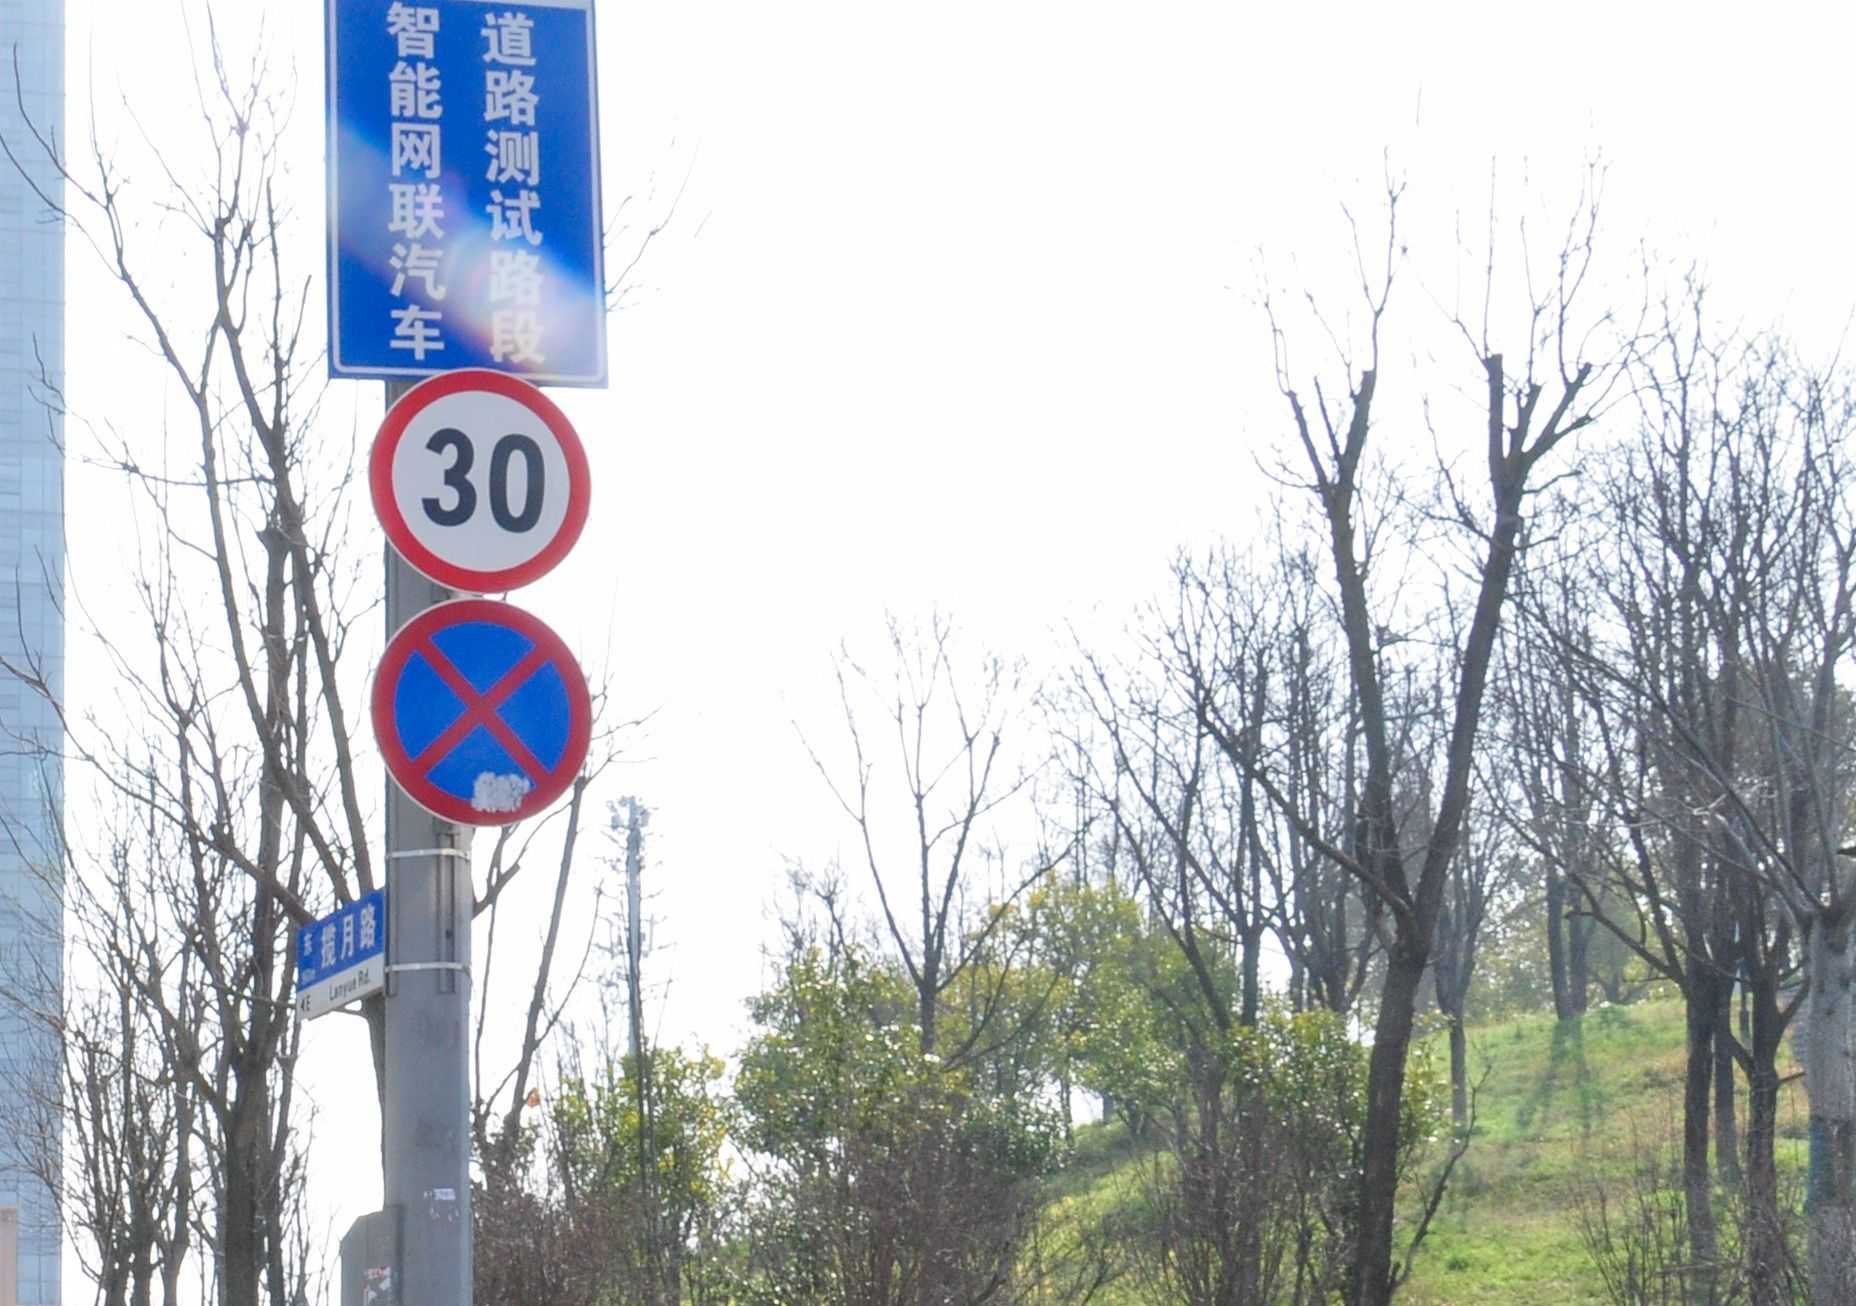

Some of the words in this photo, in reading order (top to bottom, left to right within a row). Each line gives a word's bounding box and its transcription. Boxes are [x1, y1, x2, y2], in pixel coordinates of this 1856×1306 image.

[387, 3, 447, 361] 智能网联汽车
[481, 12, 546, 365] 道路测试路段
[422, 428, 545, 534] 30
